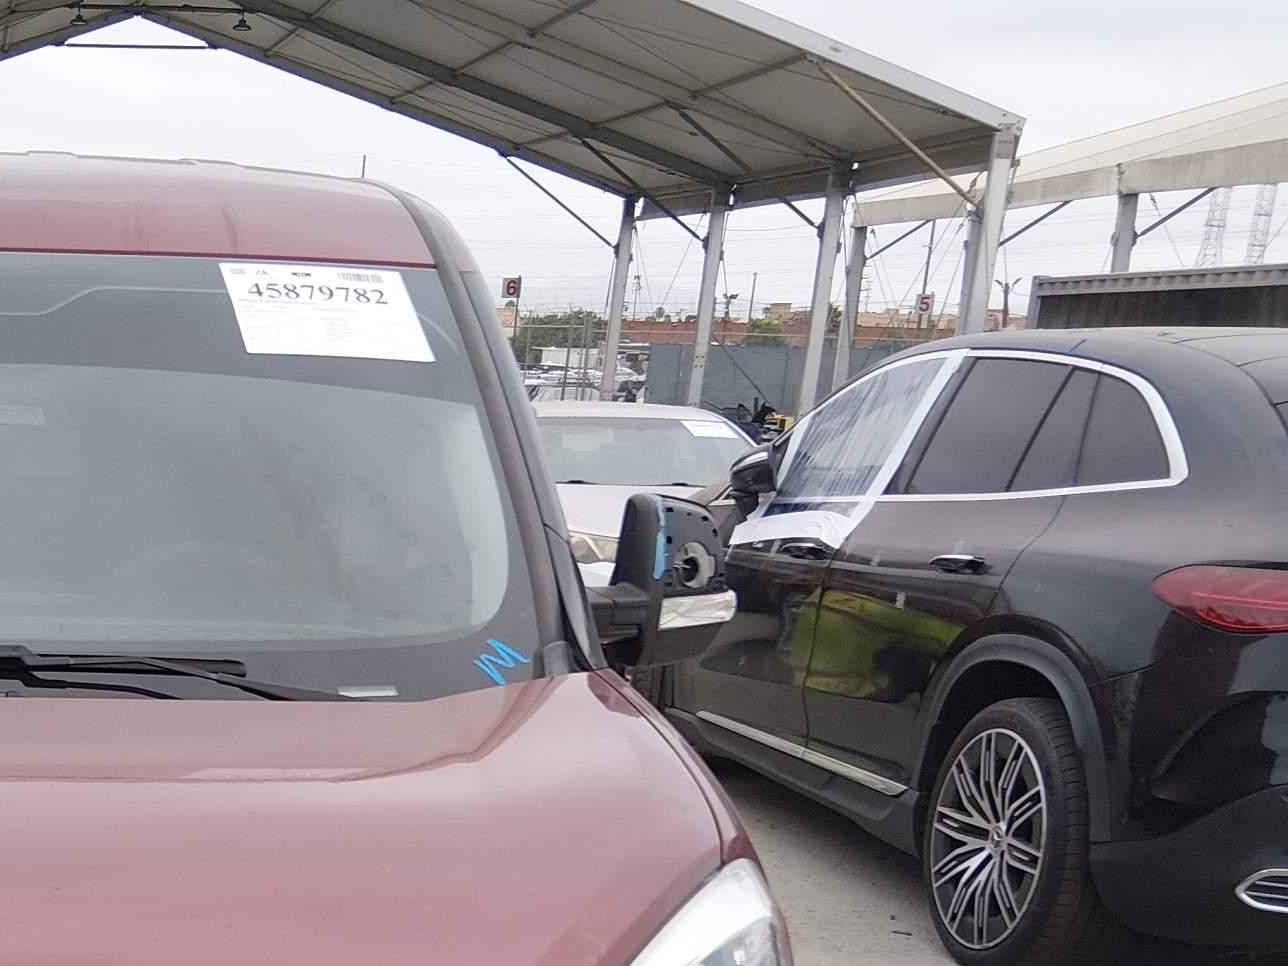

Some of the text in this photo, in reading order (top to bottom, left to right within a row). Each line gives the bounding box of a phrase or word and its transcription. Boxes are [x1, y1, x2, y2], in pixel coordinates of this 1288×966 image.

[247, 282, 388, 305] 45879782
[506, 279, 517, 296] 6
[919, 296, 931, 312] 5
